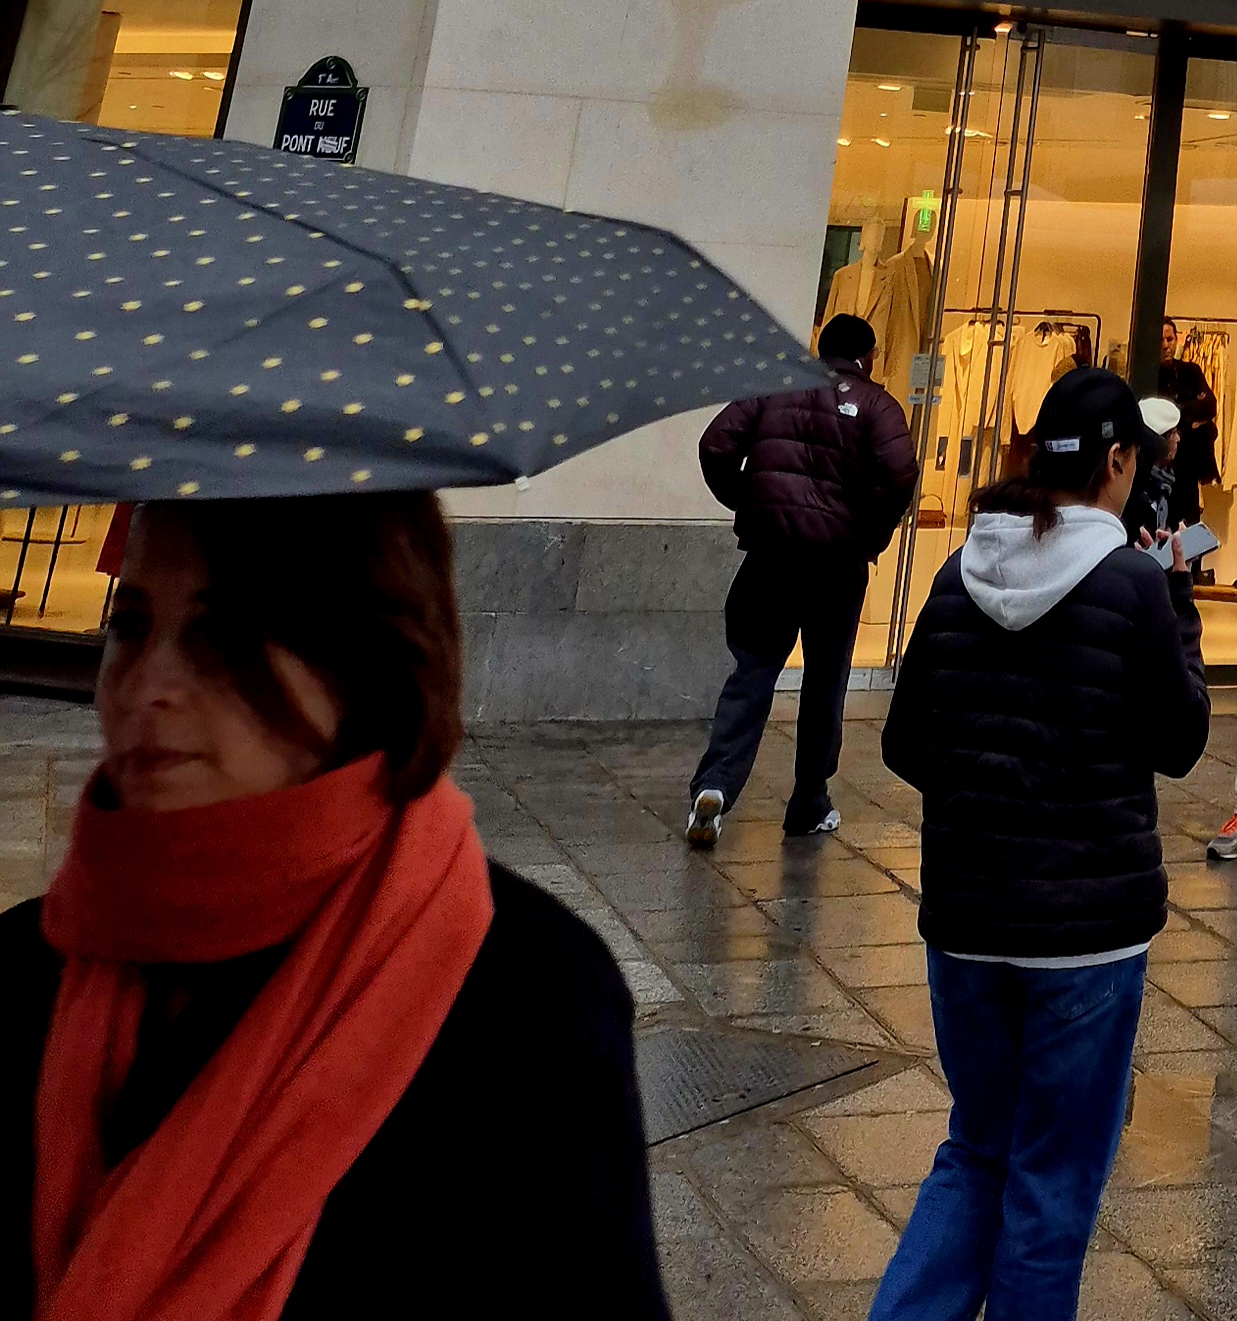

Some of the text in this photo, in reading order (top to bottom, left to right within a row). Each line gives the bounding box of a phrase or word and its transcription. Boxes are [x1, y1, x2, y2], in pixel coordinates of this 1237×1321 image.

[309, 99, 337, 116] RUE
[314, 121, 325, 130] DU
[281, 135, 315, 152] PONT
